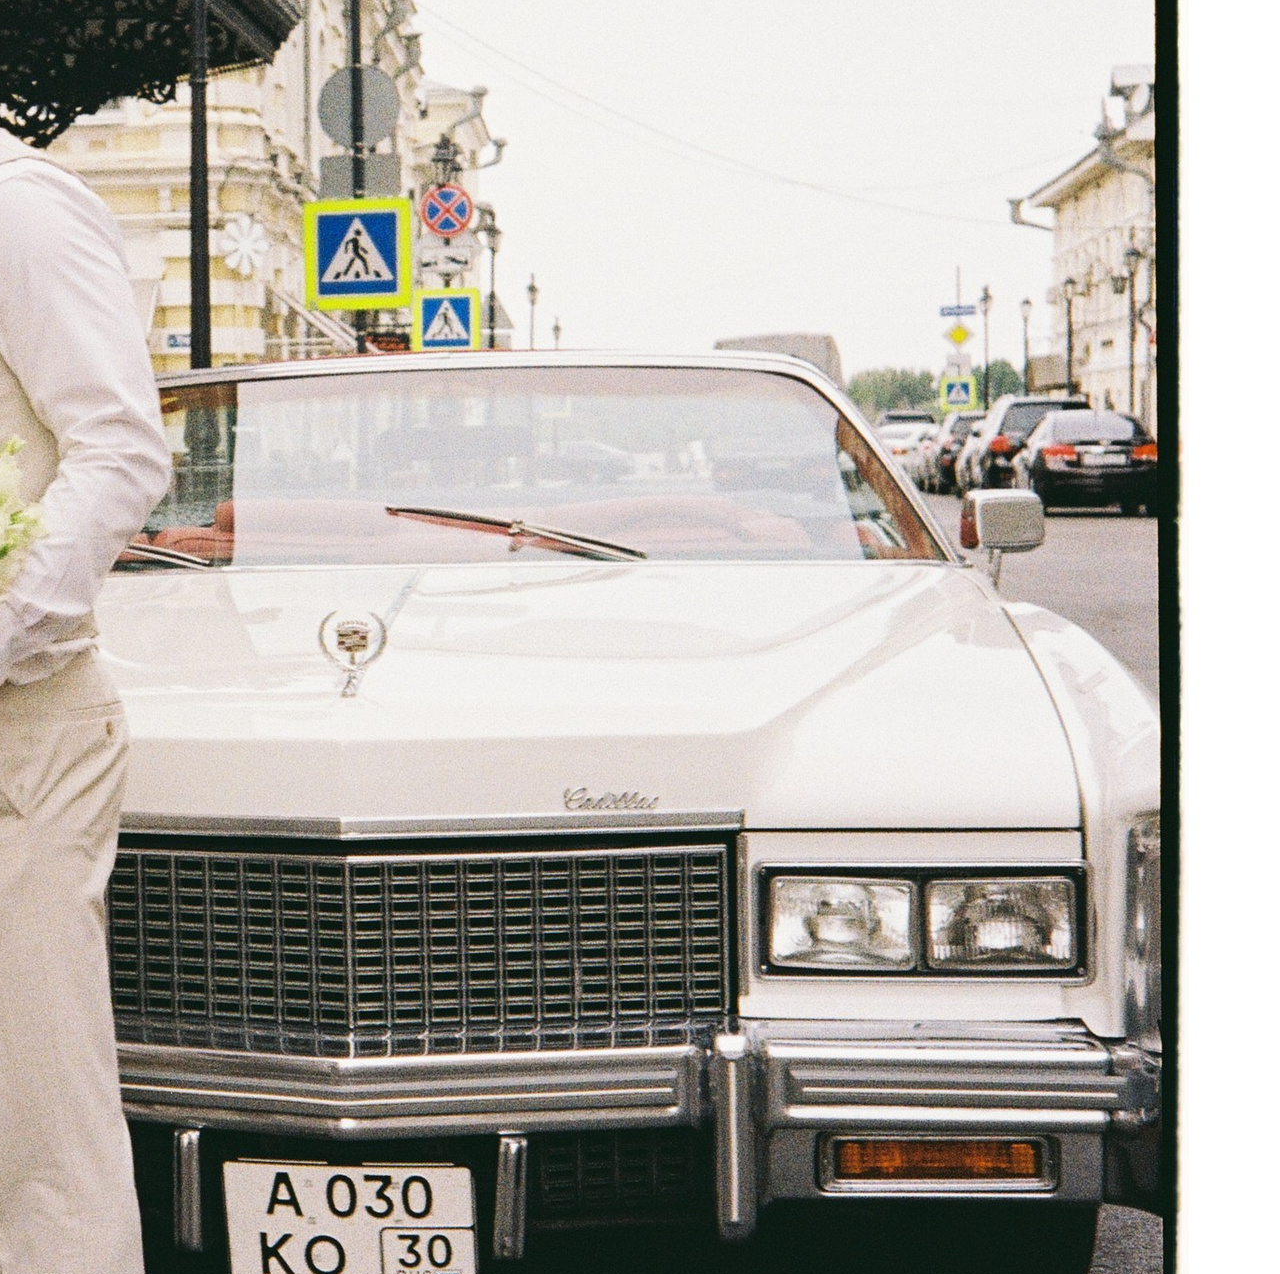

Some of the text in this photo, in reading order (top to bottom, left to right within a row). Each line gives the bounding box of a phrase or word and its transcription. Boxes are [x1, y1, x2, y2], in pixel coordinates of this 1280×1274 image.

[563, 787, 659, 810] Cadillac
[325, 1173, 433, 1219] 030
[396, 1233, 453, 1269] 30
